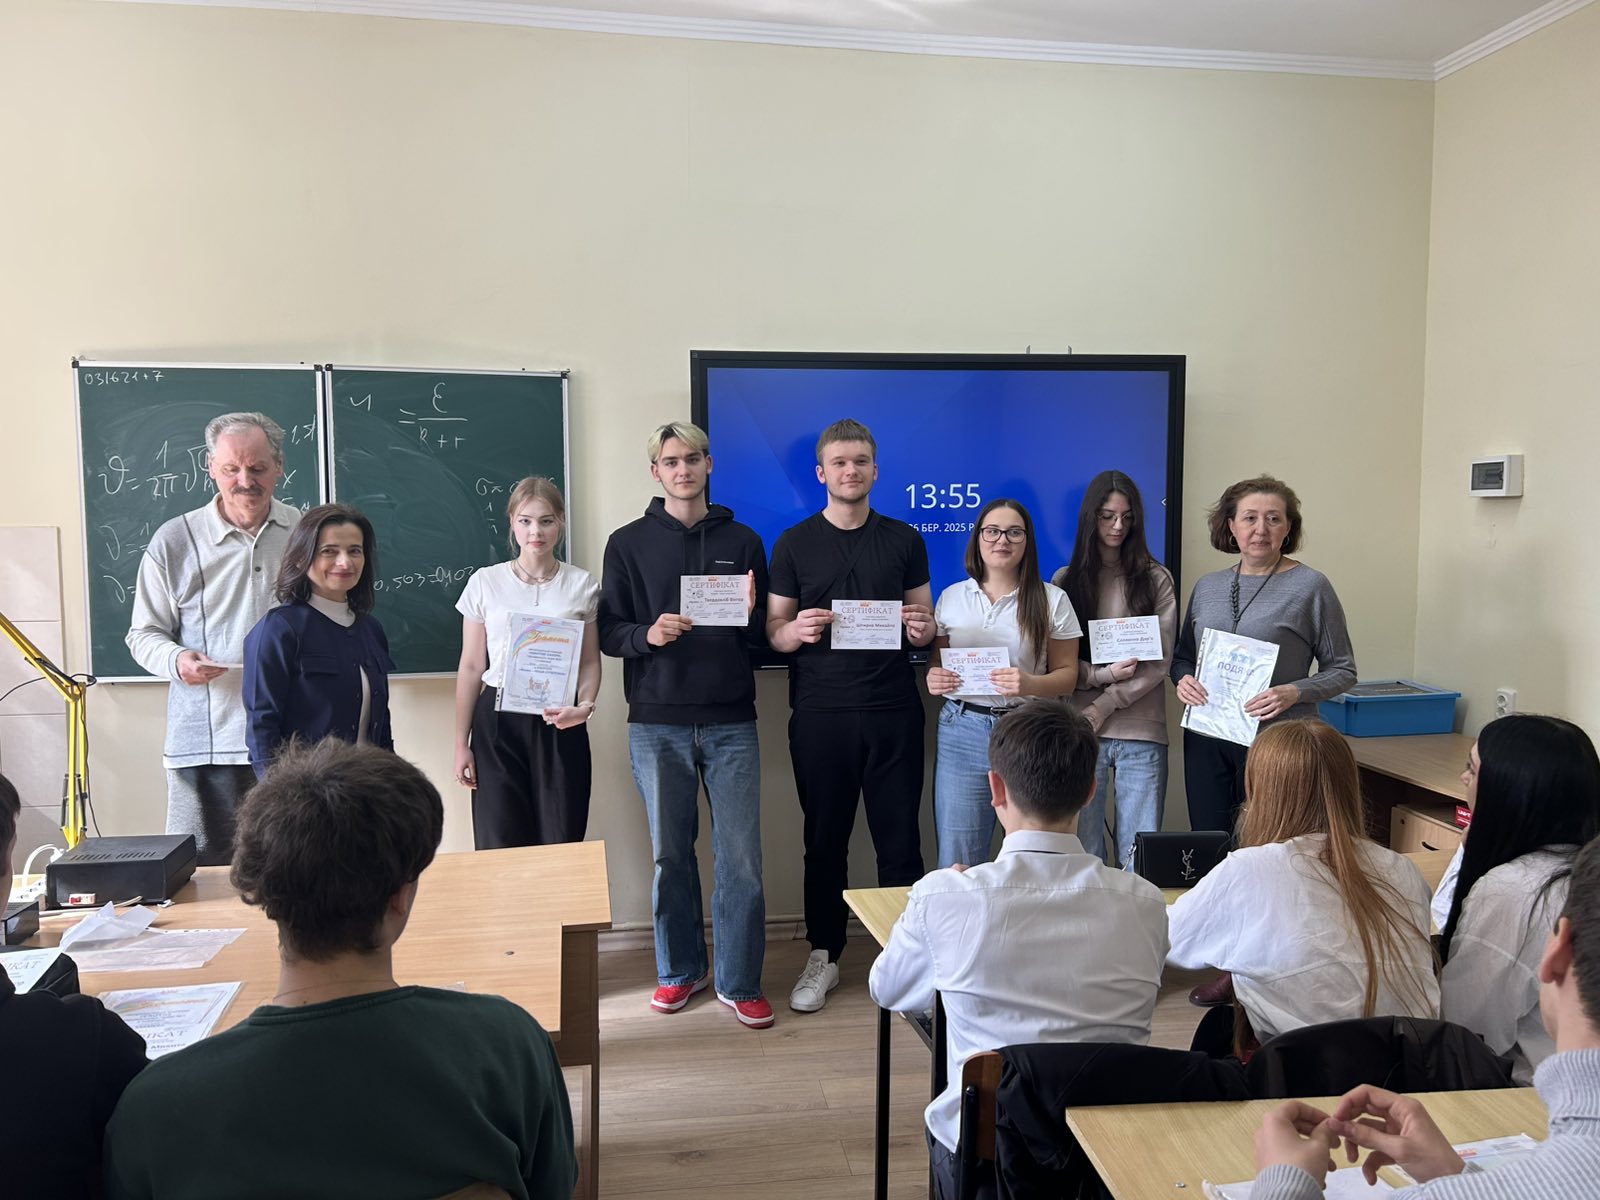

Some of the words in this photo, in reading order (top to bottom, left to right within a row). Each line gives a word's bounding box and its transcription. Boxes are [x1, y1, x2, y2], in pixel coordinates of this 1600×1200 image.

[906, 483, 981, 509] 13:55
[921, 523, 942, 533] БЕР.
[944, 522, 967, 532] 2025
[690, 581, 741, 589] СЕРТИФІКАТ
[841, 606, 894, 615] СЕРТИФІКАТ
[1098, 622, 1150, 632] СЕРТИФІКАТ
[950, 656, 1001, 665] СЕРТИФІКАТ
[1217, 660, 1255, 677] ПОДЯ
